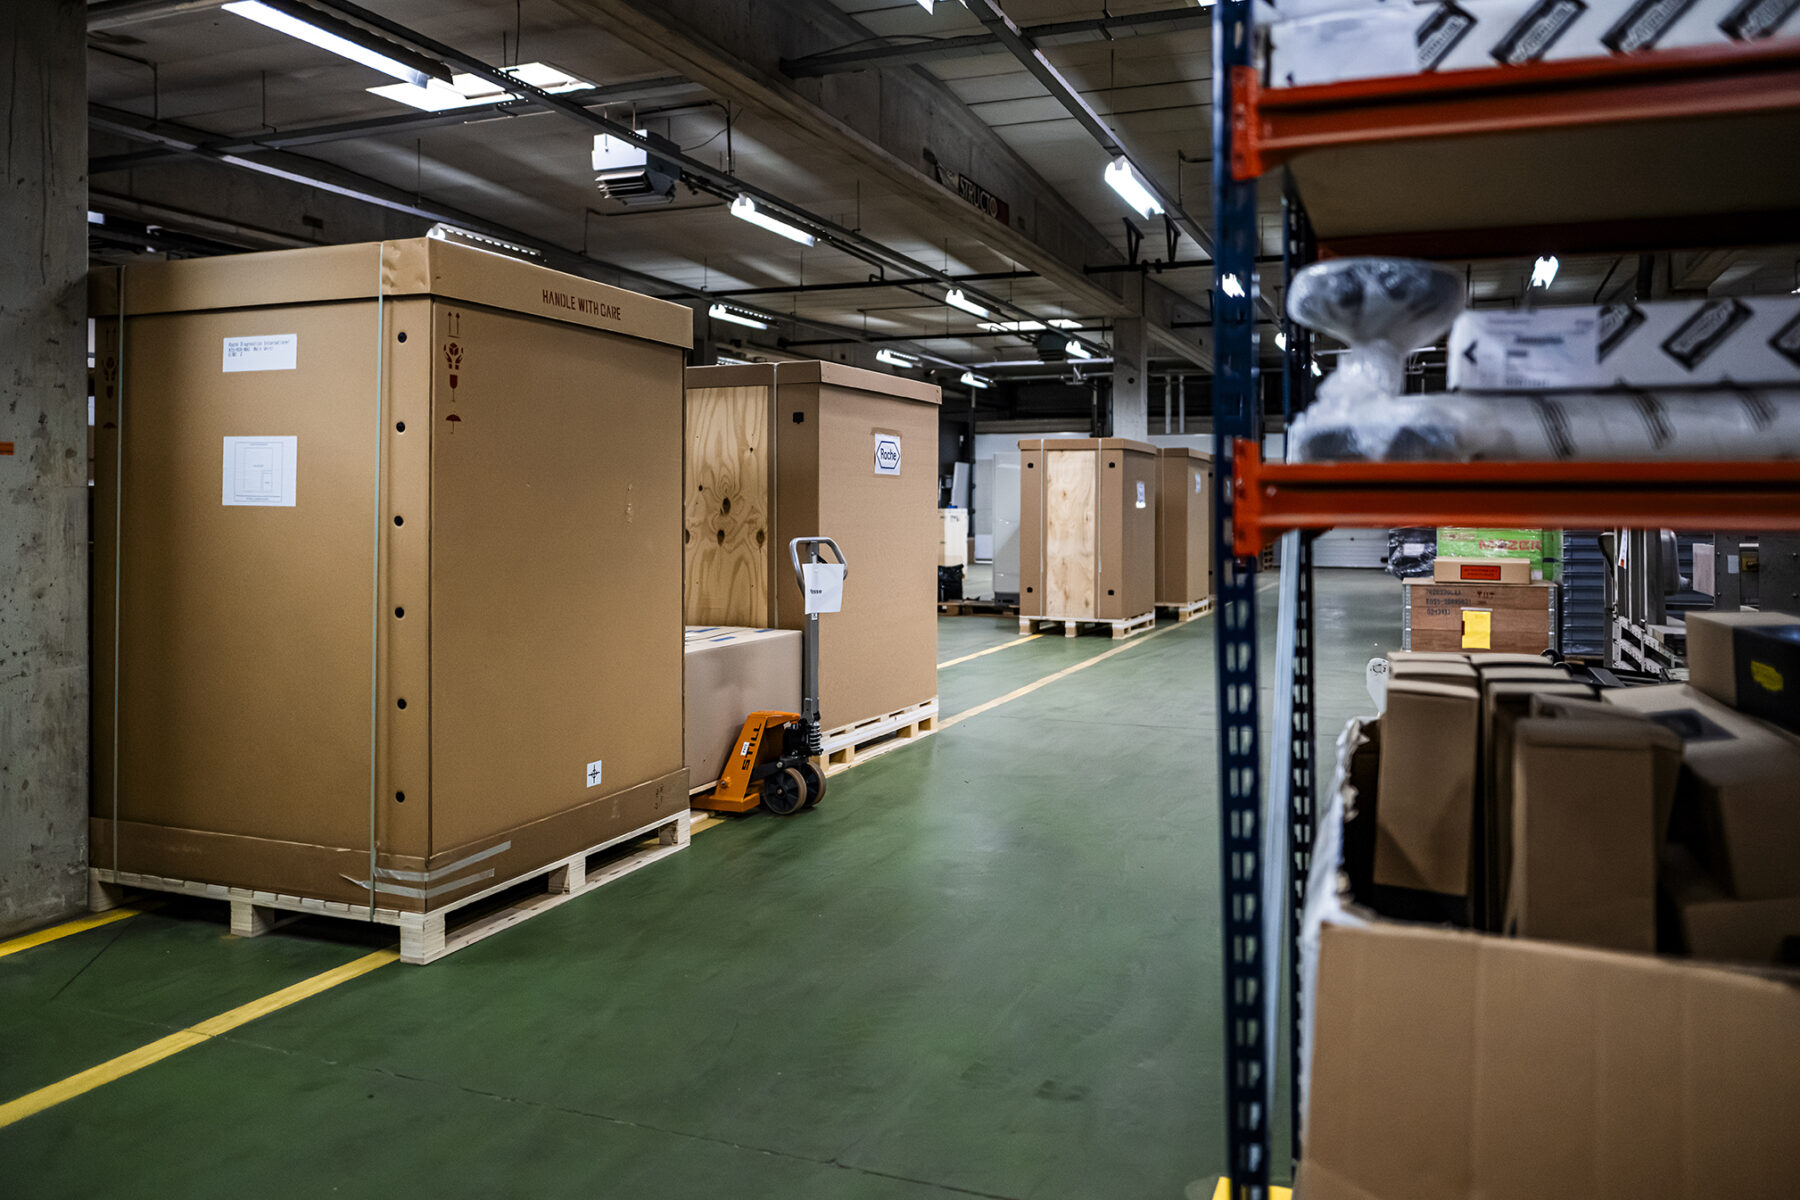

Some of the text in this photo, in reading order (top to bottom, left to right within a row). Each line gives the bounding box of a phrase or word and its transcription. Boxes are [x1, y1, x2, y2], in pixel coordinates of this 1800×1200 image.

[542, 289, 621, 321] HANDLE WITH CARE
[880, 447, 897, 461] Roche
[741, 723, 762, 770] STILL
